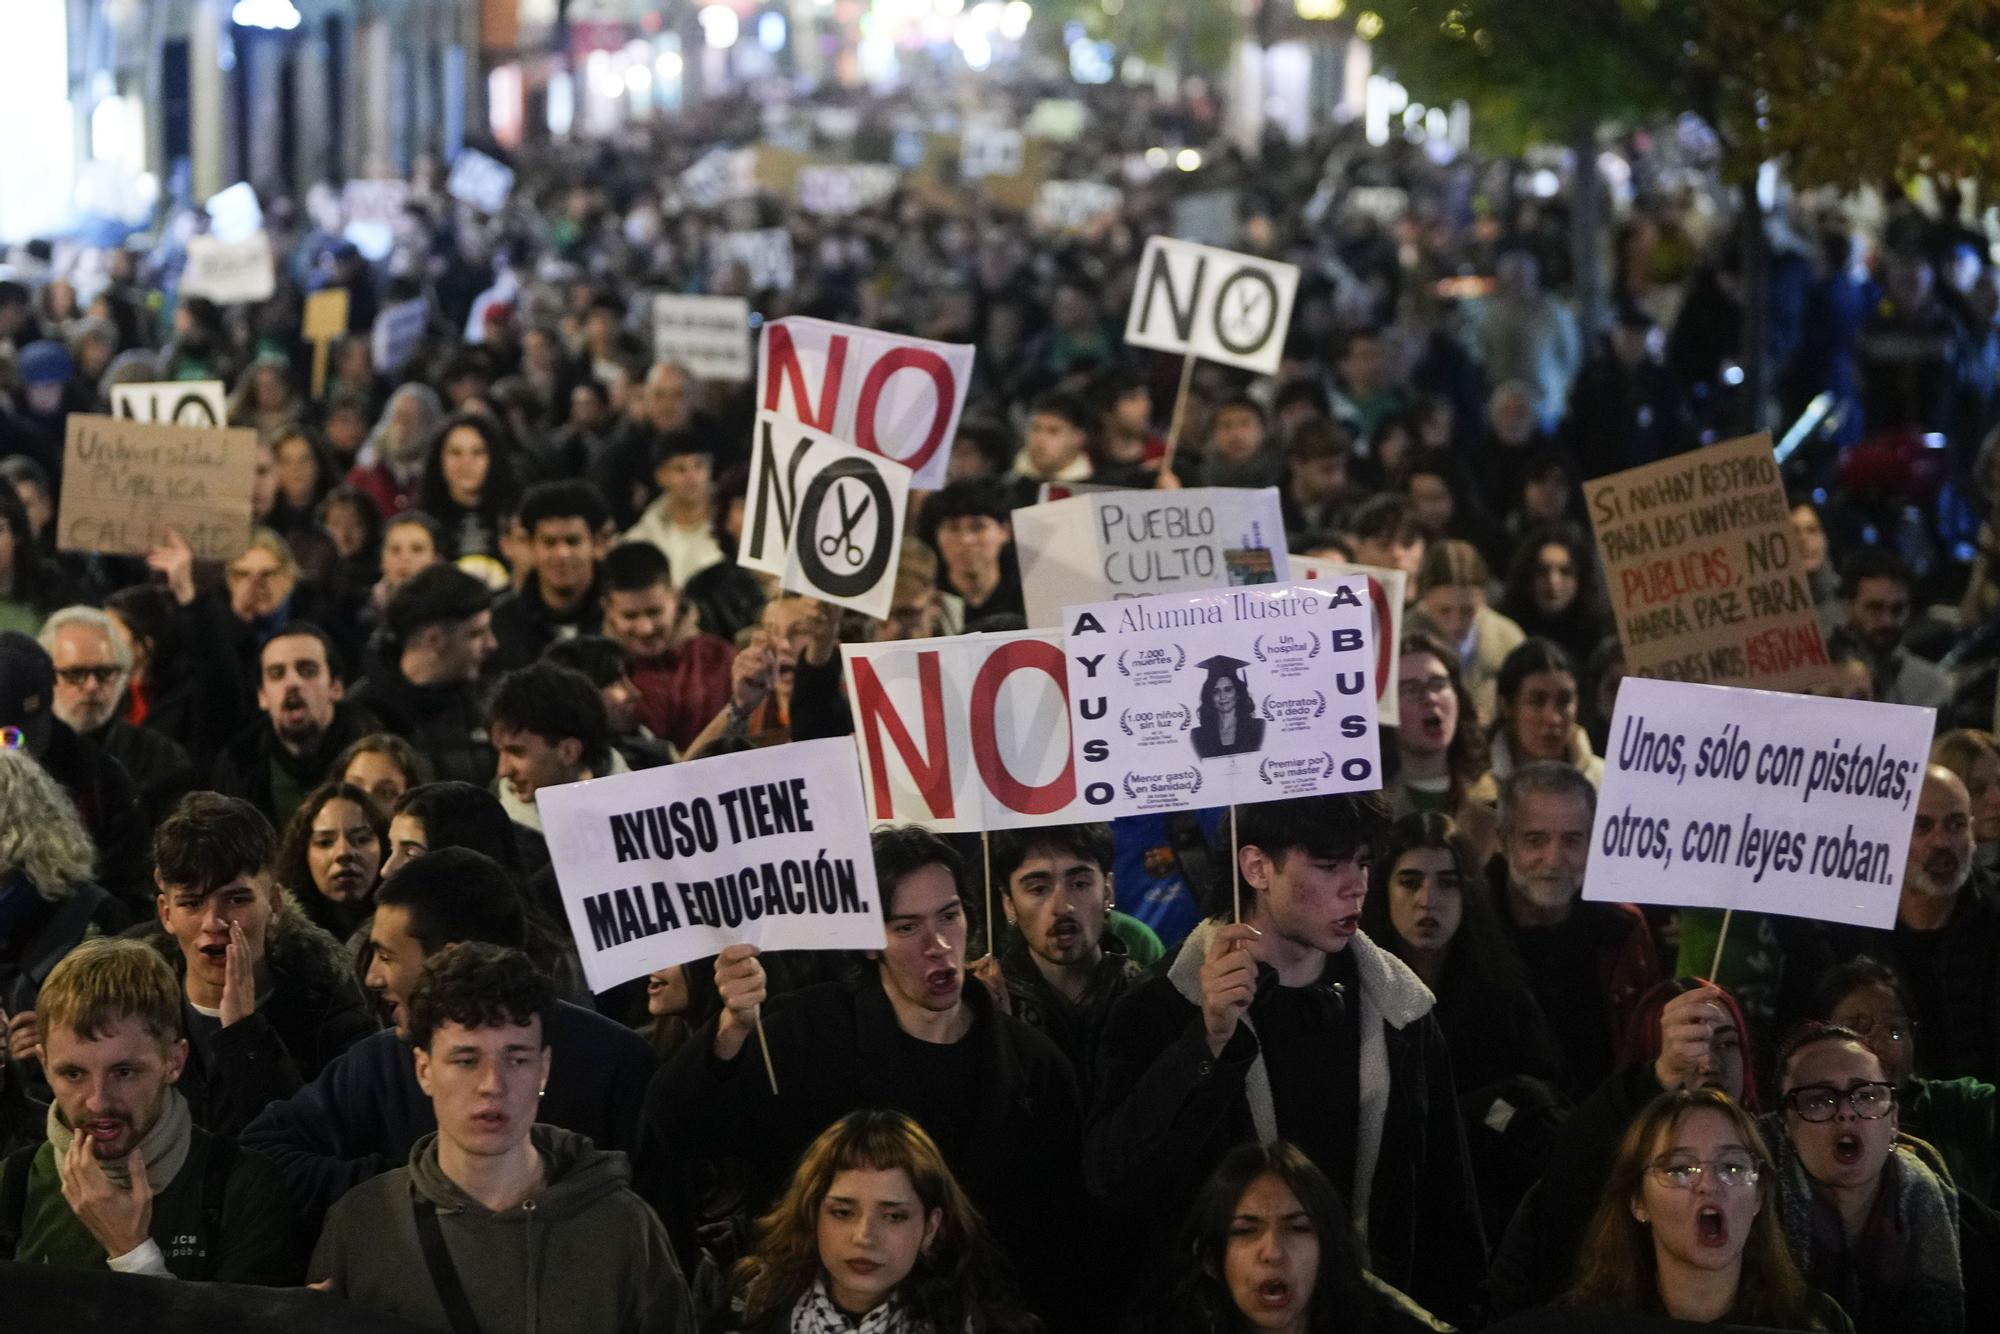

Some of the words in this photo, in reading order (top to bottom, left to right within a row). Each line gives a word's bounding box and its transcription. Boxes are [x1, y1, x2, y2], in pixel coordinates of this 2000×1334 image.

[1138, 248, 1279, 355] NO
[764, 323, 956, 473] NO
[1655, 467, 1695, 503] HAY
[749, 420, 894, 598] NO
[1101, 504, 1215, 545] PUEBLO
[1600, 519, 1655, 566] PARA
[1655, 512, 1688, 549] LAS
[1743, 530, 1792, 576] NO
[1118, 602, 1223, 633] Alumna
[1233, 592, 1319, 621] Ilustre
[1692, 590, 1748, 631] PAZ
[1746, 574, 1815, 618] PARA
[1138, 649, 1165, 659] 7.000
[1267, 642, 1307, 654] hospital
[1279, 635, 1294, 644] Un
[1131, 656, 1173, 667] muertes
[1268, 698, 1318, 709] Contratos
[1328, 585, 1372, 782] ABUSO
[851, 639, 1077, 820] NO
[1071, 612, 1115, 806] AYUSO
[1139, 721, 1155, 730] sin
[1157, 719, 1172, 728] luz
[1156, 710, 1184, 720] niños
[1285, 706, 1311, 716] dedo
[1131, 774, 1162, 783] Menor
[1165, 771, 1195, 784] gasto
[1308, 756, 1325, 767] por
[1619, 715, 1687, 786] Unos,
[1694, 724, 1752, 783] sólo
[1756, 743, 1804, 787] con
[1803, 738, 1919, 812] pistolas;
[1136, 786, 1148, 794] en
[1150, 781, 1192, 793] Sanidad
[609, 796, 719, 864] AYUSO
[719, 778, 814, 846] TIENE
[1603, 812, 1673, 869] otros,
[1682, 820, 1729, 866] con
[1735, 813, 1808, 883] leyes
[1809, 824, 1894, 886] roban.
[583, 881, 683, 952] MALA
[676, 848, 870, 930] EDUCACIÓN.
